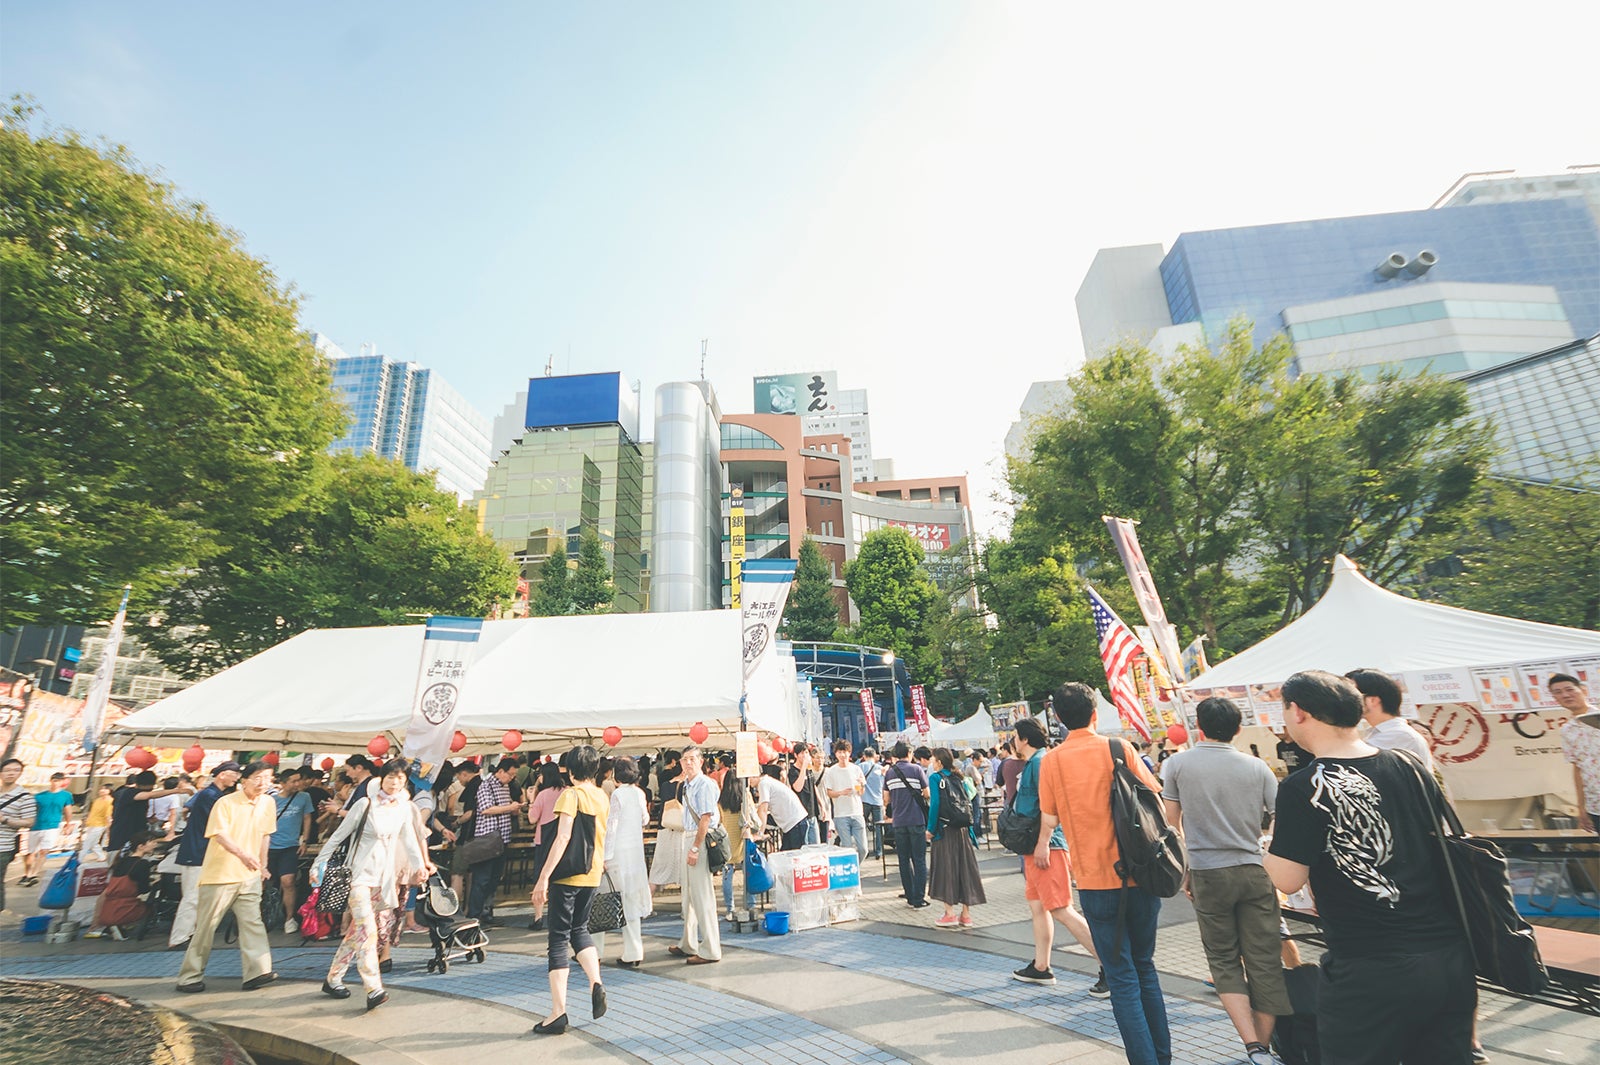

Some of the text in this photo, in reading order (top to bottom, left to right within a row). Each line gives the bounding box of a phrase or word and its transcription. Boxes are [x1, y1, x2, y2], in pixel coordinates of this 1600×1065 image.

[807, 375, 828, 412] えん
[434, 659, 463, 668] 大江戸
[1422, 673, 1453, 681] BEER
[1422, 683, 1461, 691] ORDER
[1429, 693, 1460, 701] HERE
[796, 865, 827, 879] 可燃ごみ
[829, 863, 858, 877] 不燃ごみ
